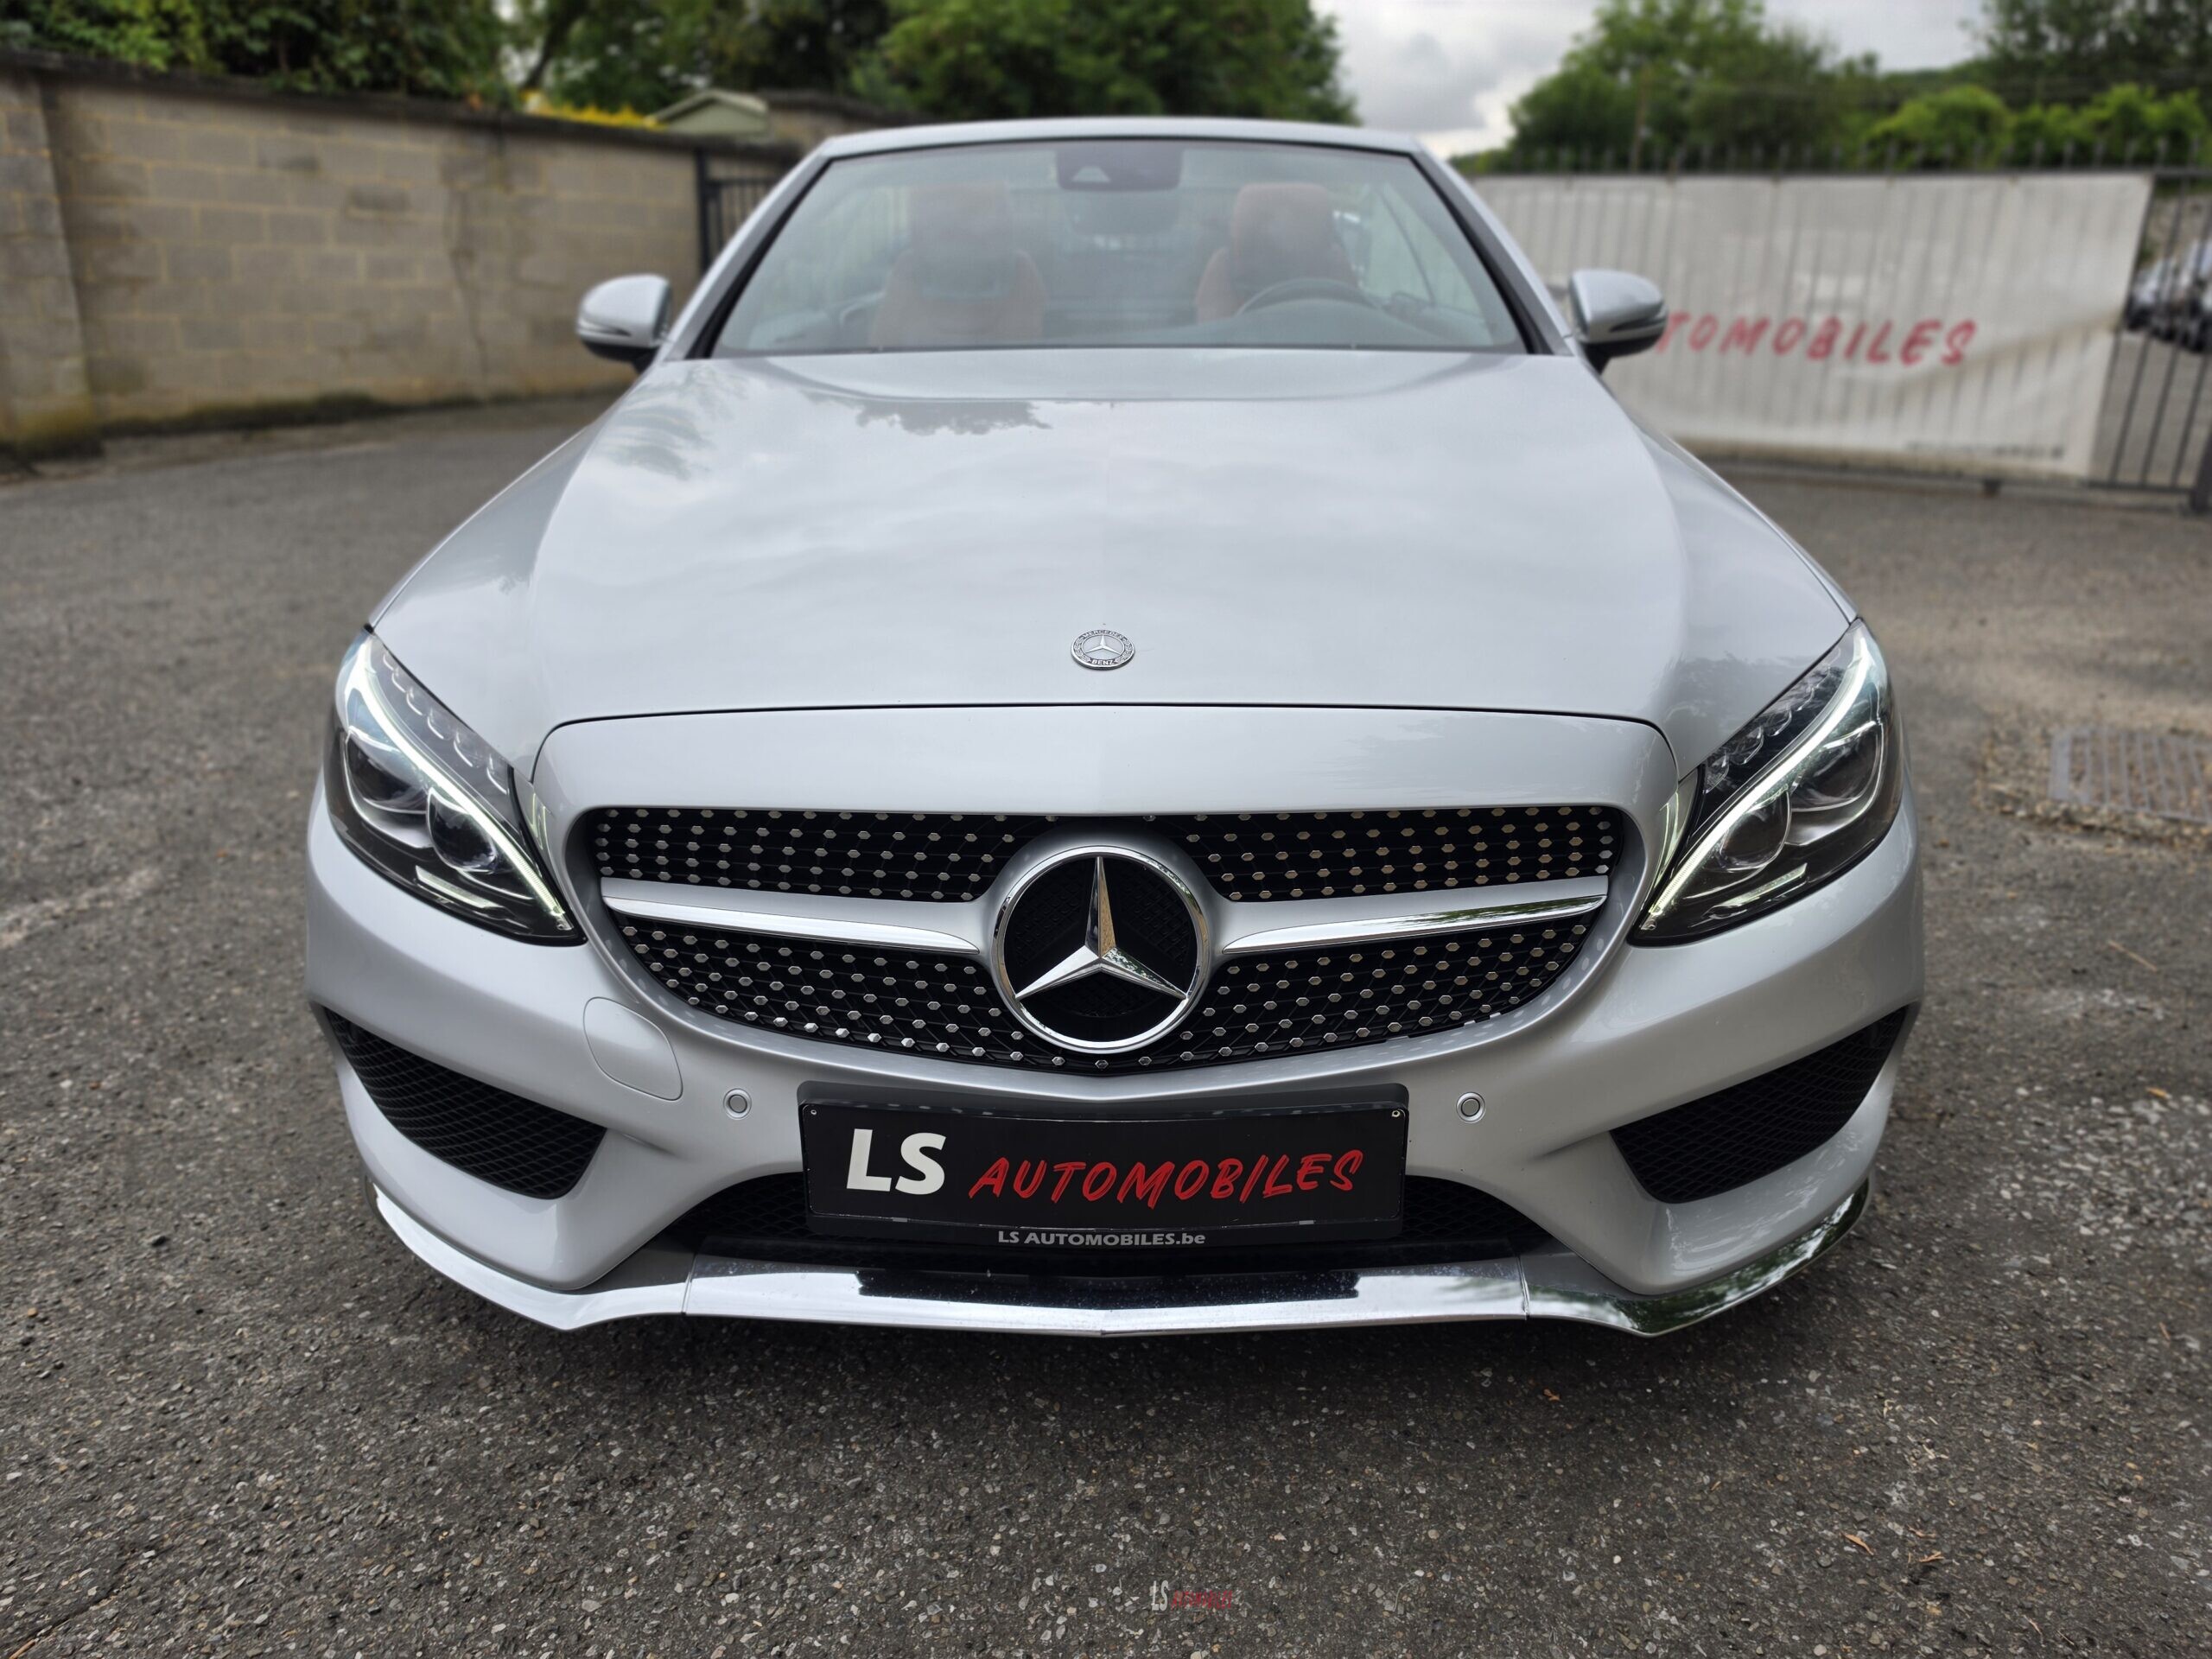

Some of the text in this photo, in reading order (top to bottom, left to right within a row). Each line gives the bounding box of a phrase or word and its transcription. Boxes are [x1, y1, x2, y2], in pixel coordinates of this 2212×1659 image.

[1655, 311, 1977, 366] TOMOBILES
[847, 1128, 1363, 1210] LS AUTOMOBILES
[999, 1230, 1206, 1246] LS AUTOMOBILES.be
